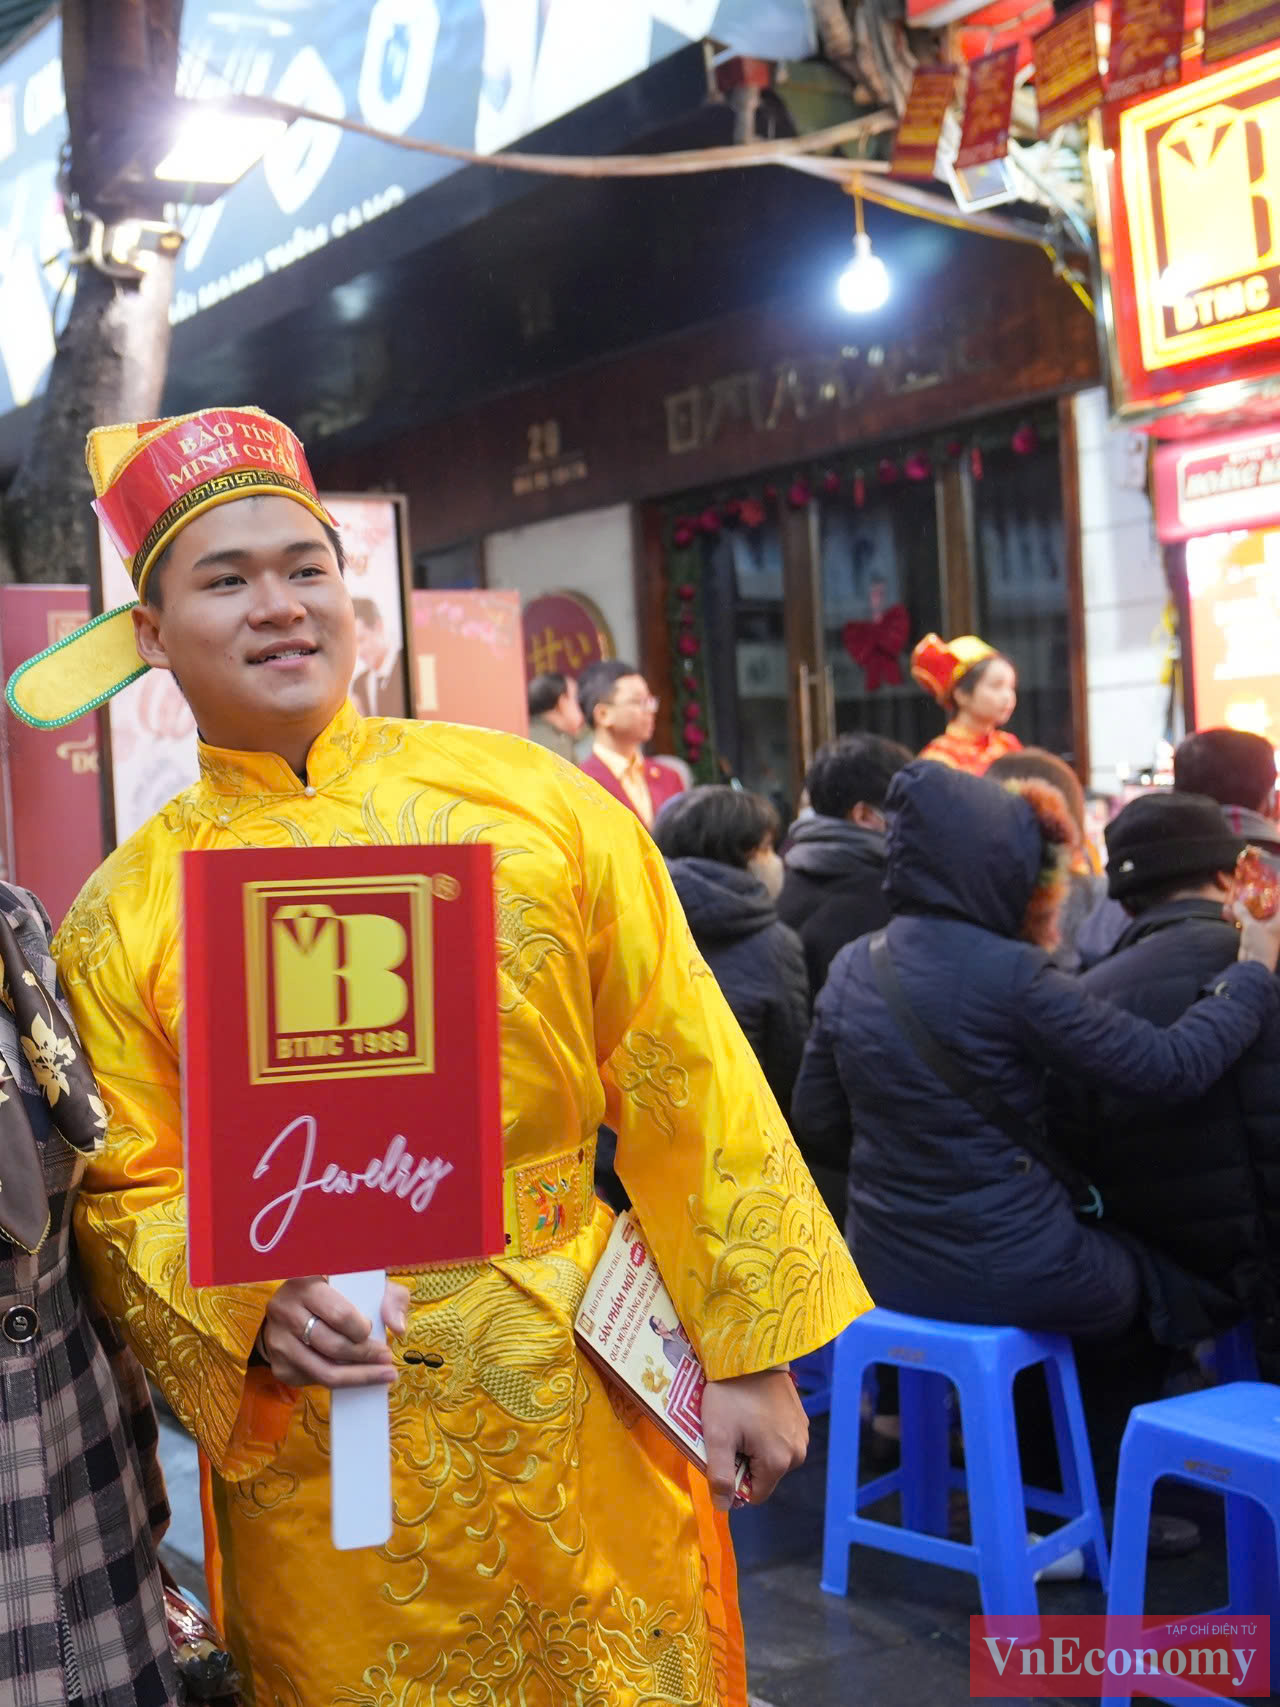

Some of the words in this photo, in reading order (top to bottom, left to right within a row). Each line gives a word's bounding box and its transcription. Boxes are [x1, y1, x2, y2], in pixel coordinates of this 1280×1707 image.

[236, 422, 276, 446] TÍN
[168, 444, 239, 489] MINH
[275, 1034, 345, 1059] BTMC
[349, 1029, 409, 1055] 1989
[249, 1114, 455, 1253] Jewelry
